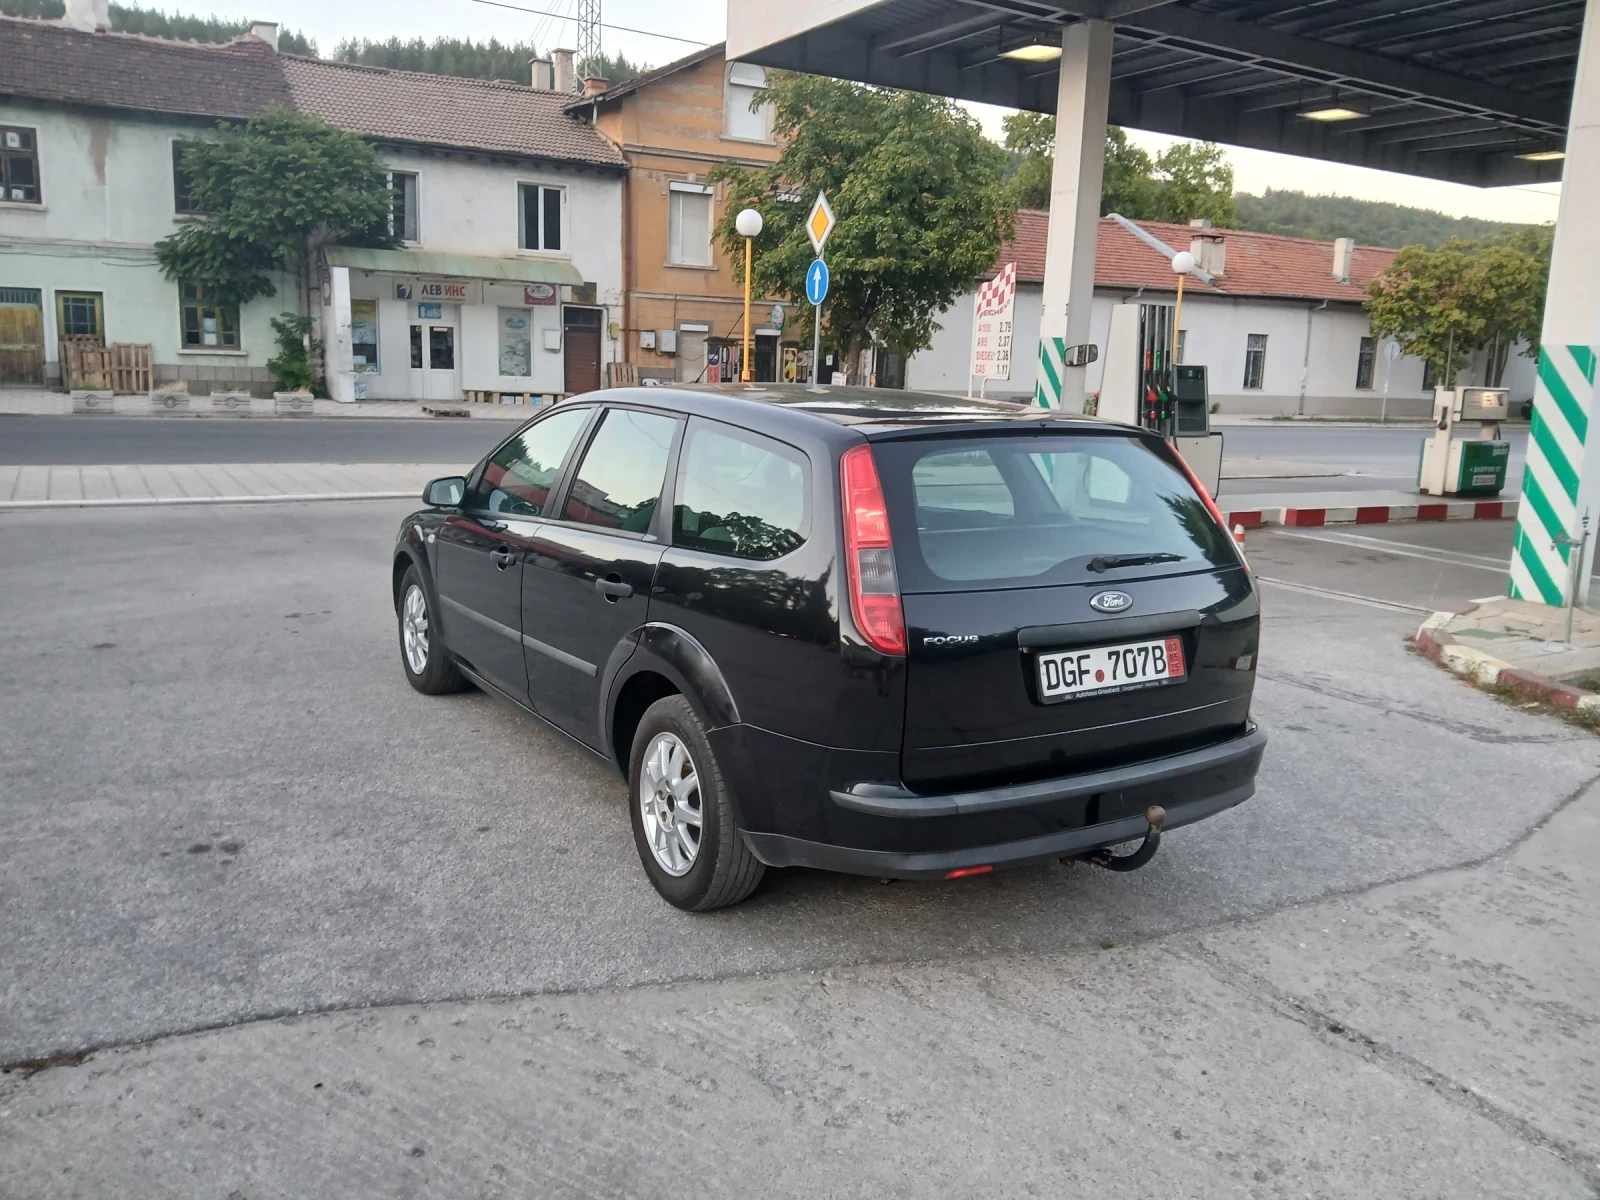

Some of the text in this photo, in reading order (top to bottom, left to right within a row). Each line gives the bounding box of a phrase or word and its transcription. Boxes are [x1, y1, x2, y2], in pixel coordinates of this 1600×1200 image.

[421, 284, 466, 297] ЛЕВ ИНС
[977, 335, 1010, 347] A95 2.37
[975, 364, 1008, 375] GAS 1.11
[923, 634, 979, 646] FOCUS
[1043, 645, 1167, 690] DGF 707B
[1170, 662, 1180, 672] 25
[1075, 690, 1098, 699] Autohaus
